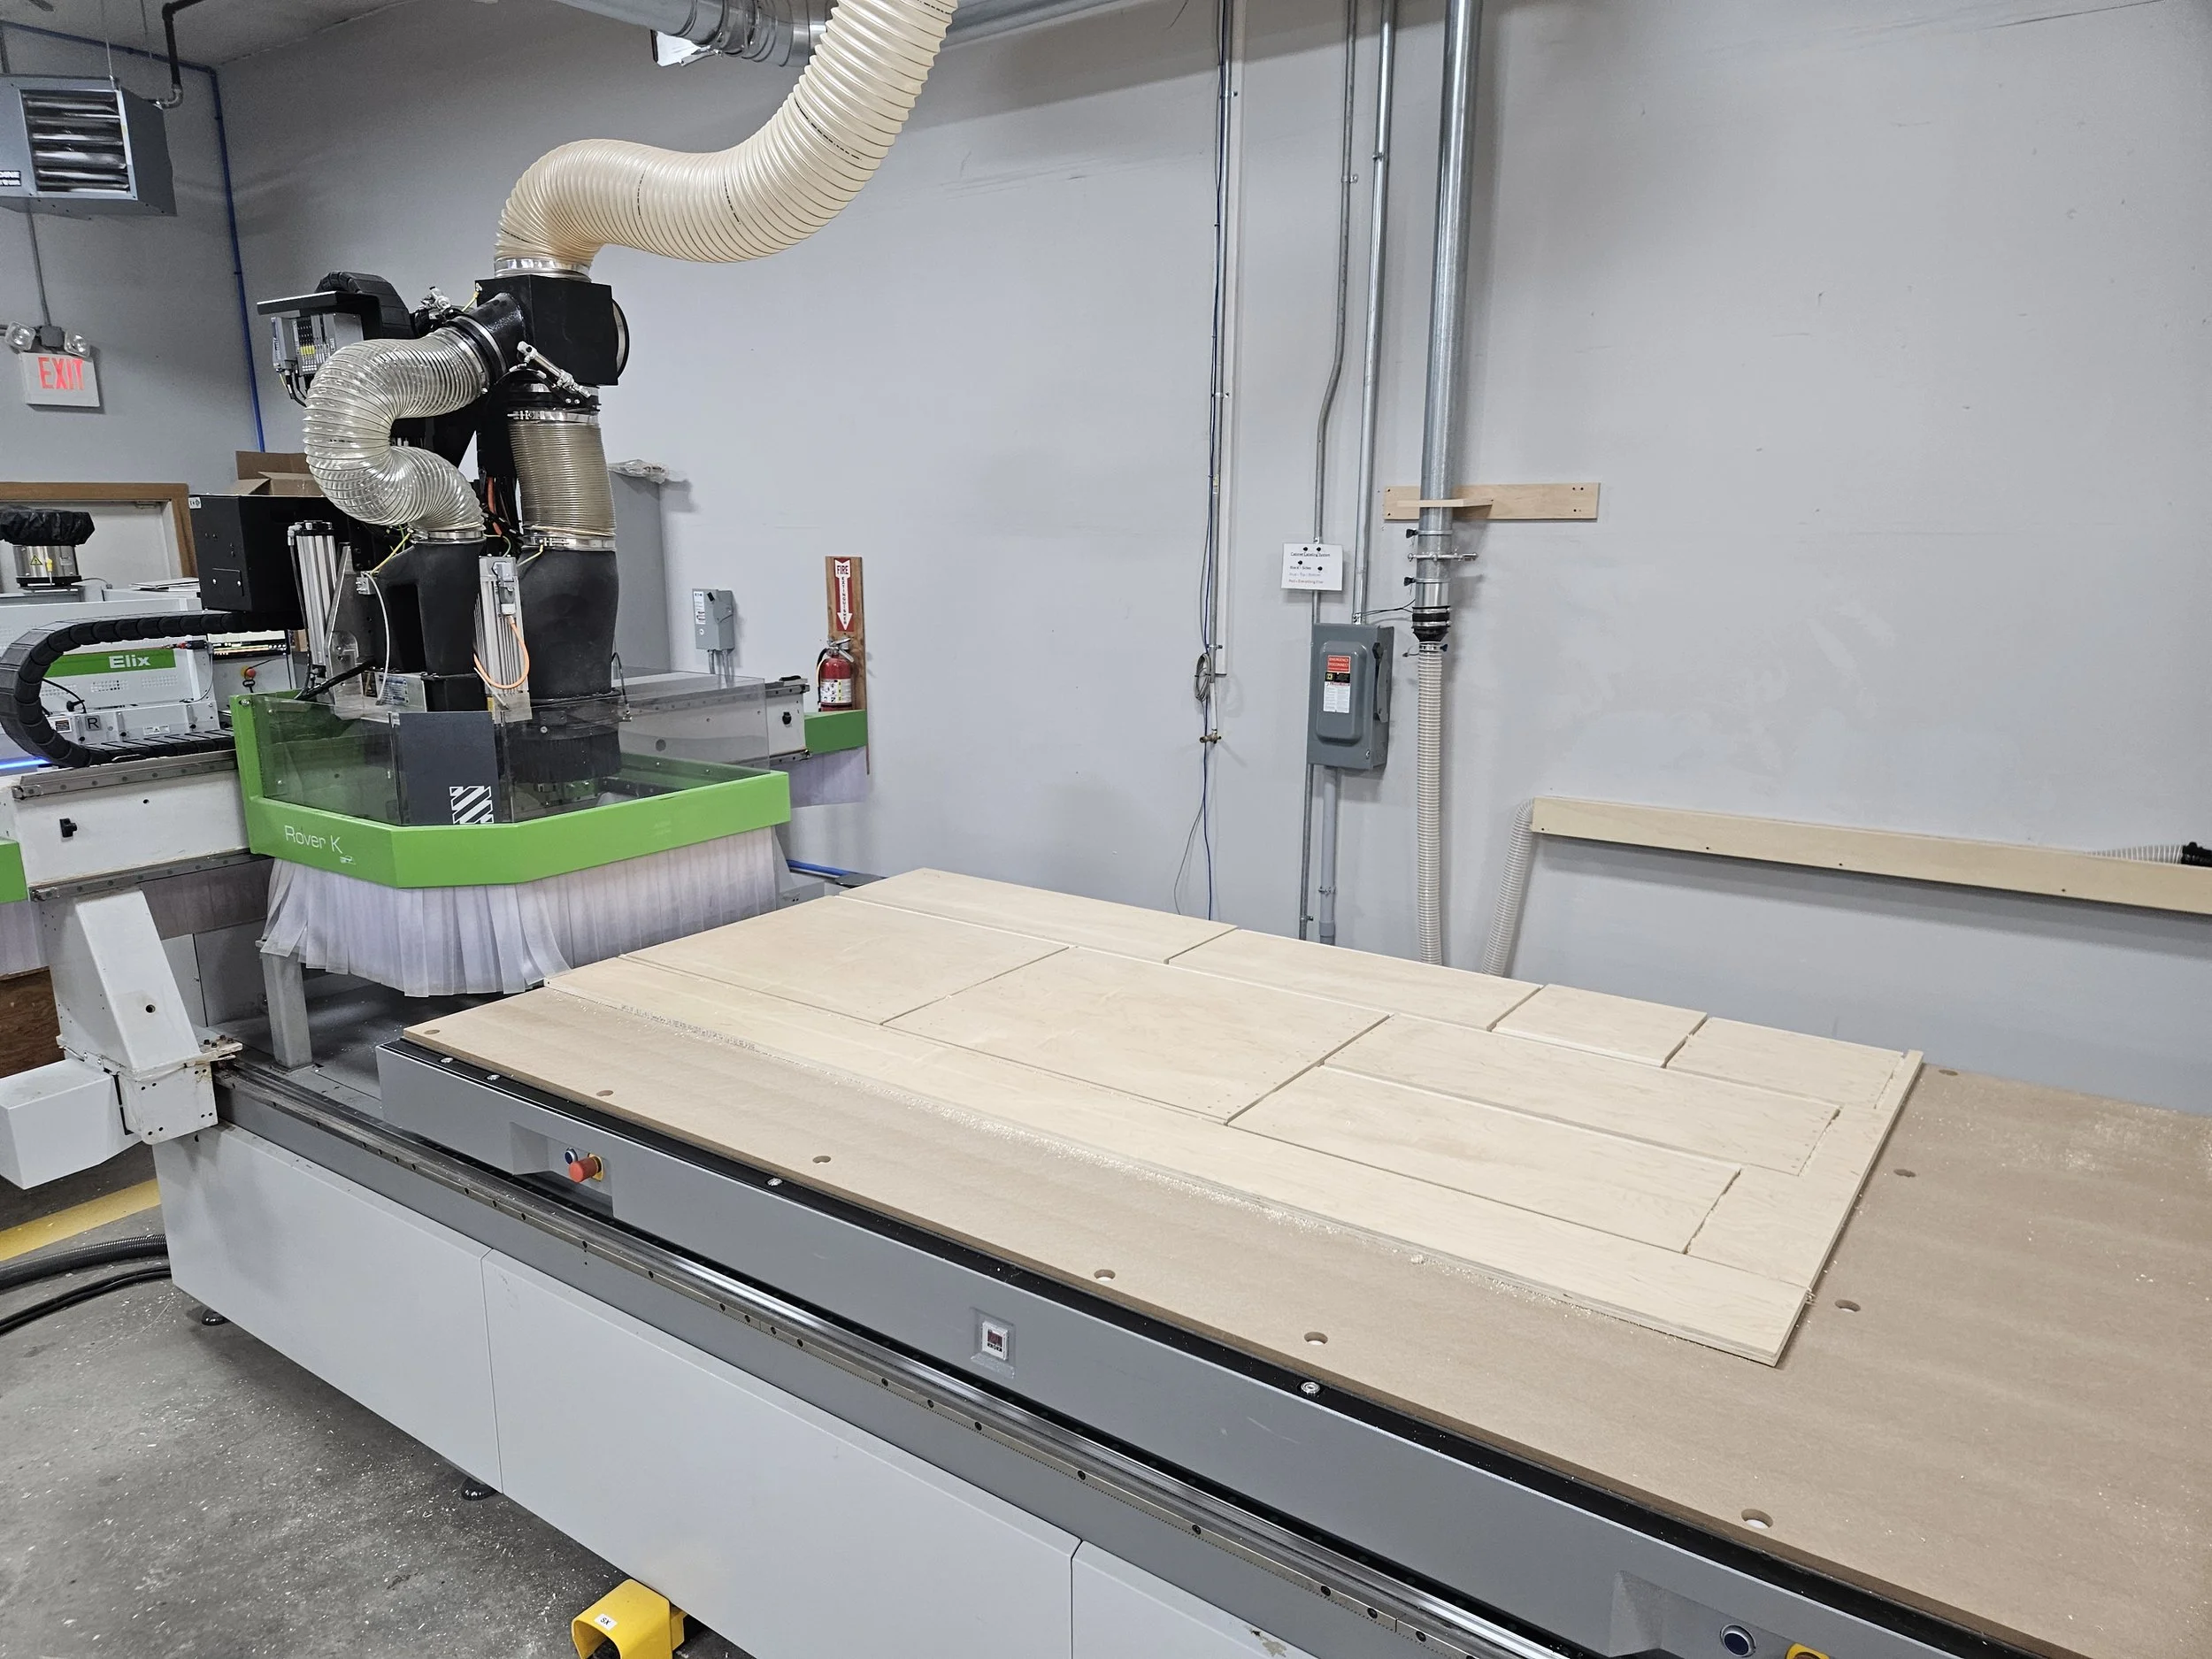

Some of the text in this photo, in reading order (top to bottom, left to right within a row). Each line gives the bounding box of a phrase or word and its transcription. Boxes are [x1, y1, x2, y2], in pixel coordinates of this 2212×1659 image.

[38, 357, 85, 390] EXIT
[836, 565, 849, 575] FIRE
[108, 654, 151, 669] Elix
[87, 718, 100, 729] R
[284, 825, 343, 854] Rover K
